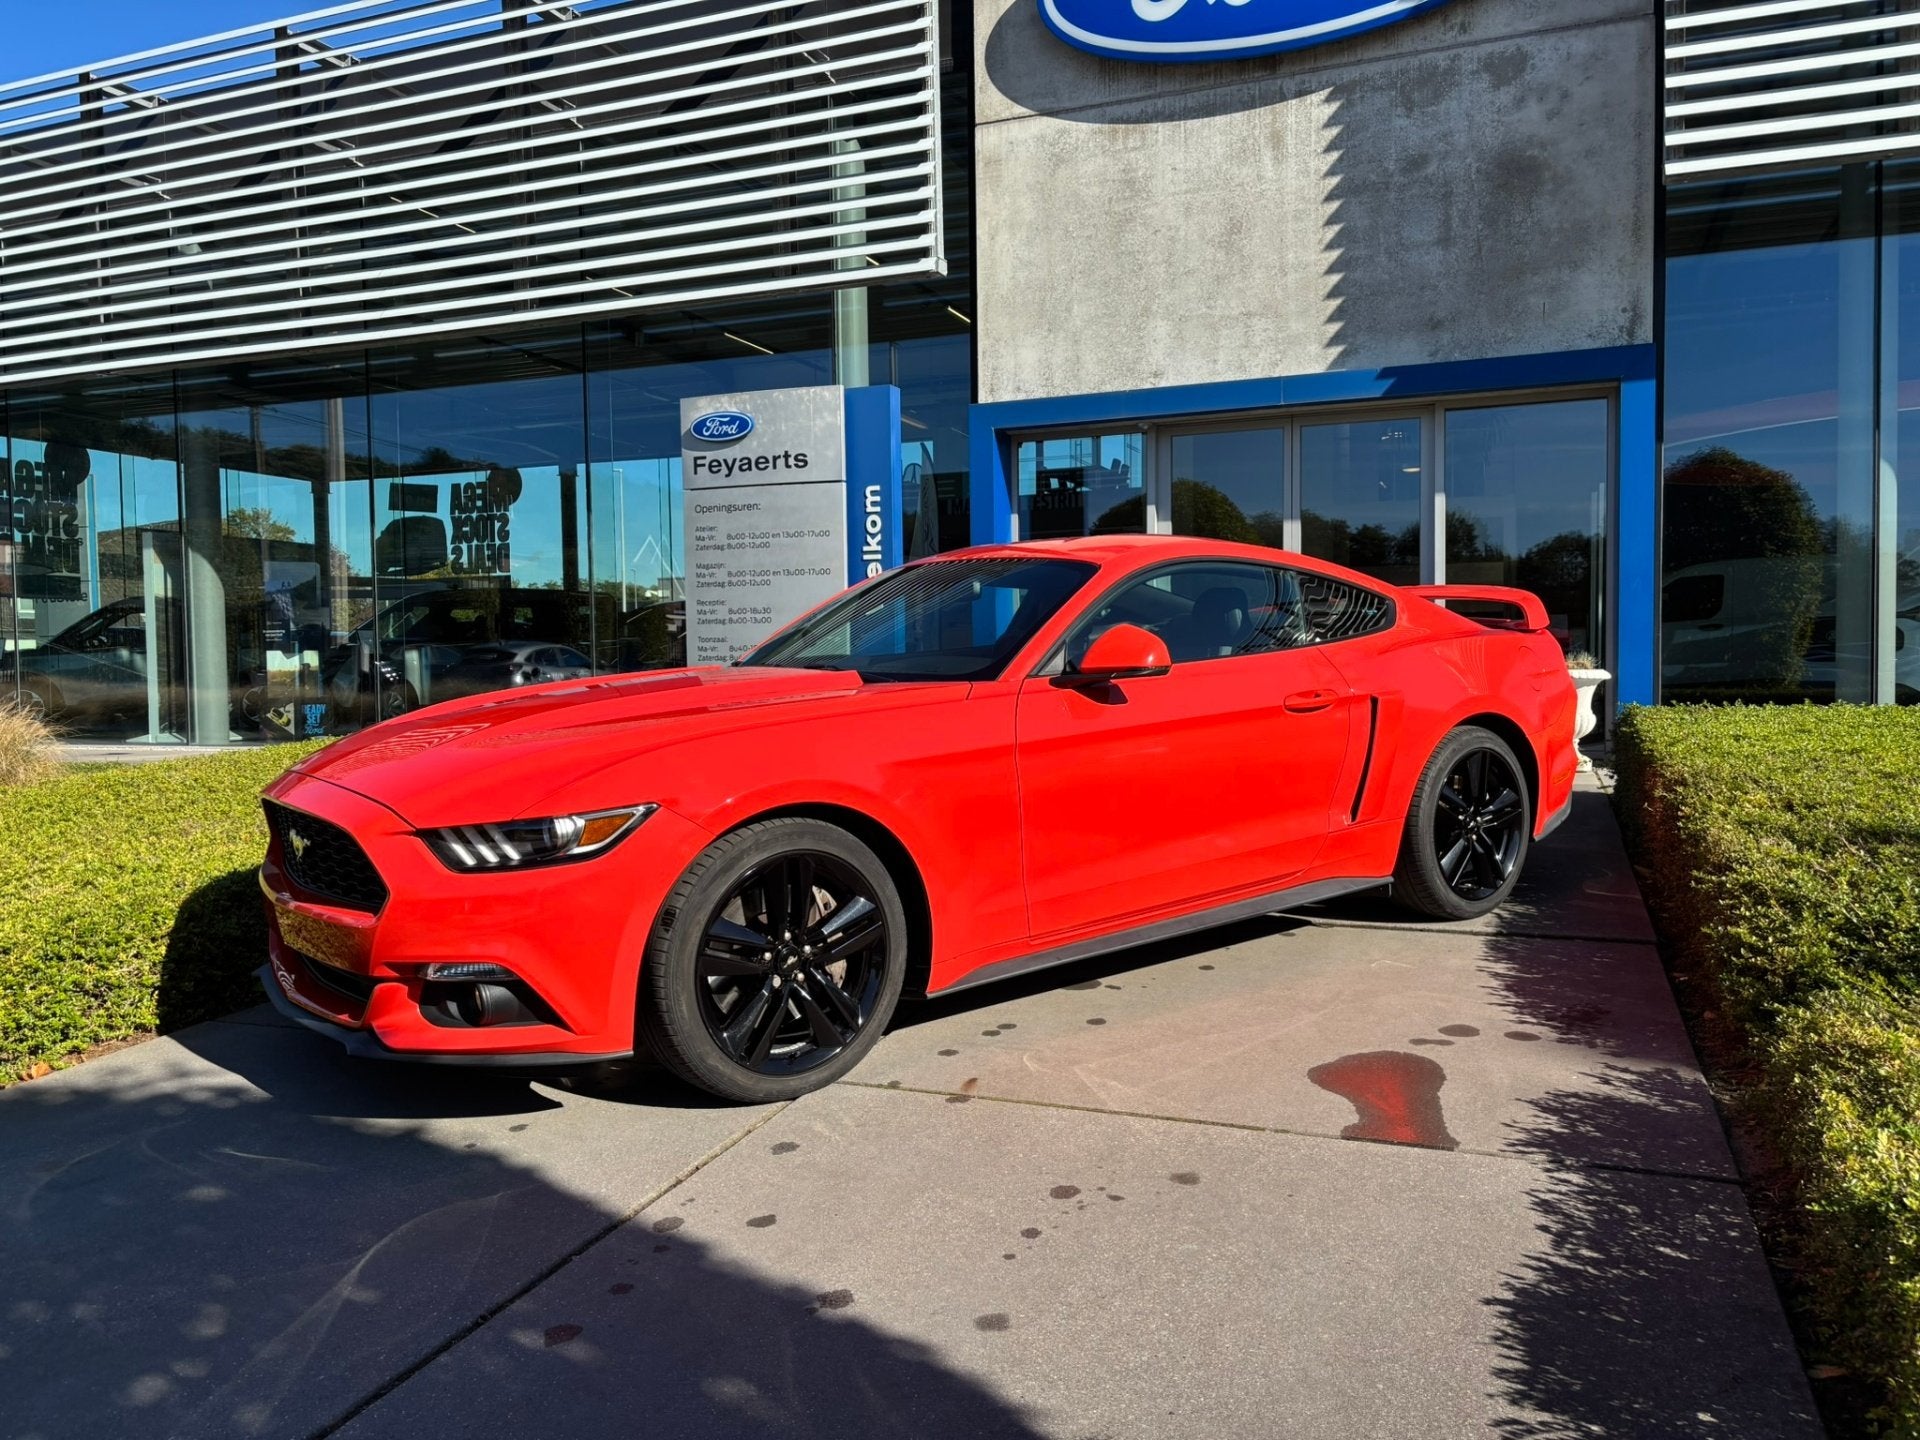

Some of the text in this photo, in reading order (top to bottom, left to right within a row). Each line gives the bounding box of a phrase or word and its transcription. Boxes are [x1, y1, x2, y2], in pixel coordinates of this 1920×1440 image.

[702, 417, 739, 436] Ford
[693, 450, 808, 478] Feyaerts
[694, 503, 761, 515] Openingsuren:
[726, 532, 770, 541] 8u00-12u00
[782, 530, 830, 538] 13u00-17u00
[862, 485, 882, 578] elkom
[727, 569, 771, 578] 8u00-12u00
[782, 567, 831, 576] 13u00-17u00
